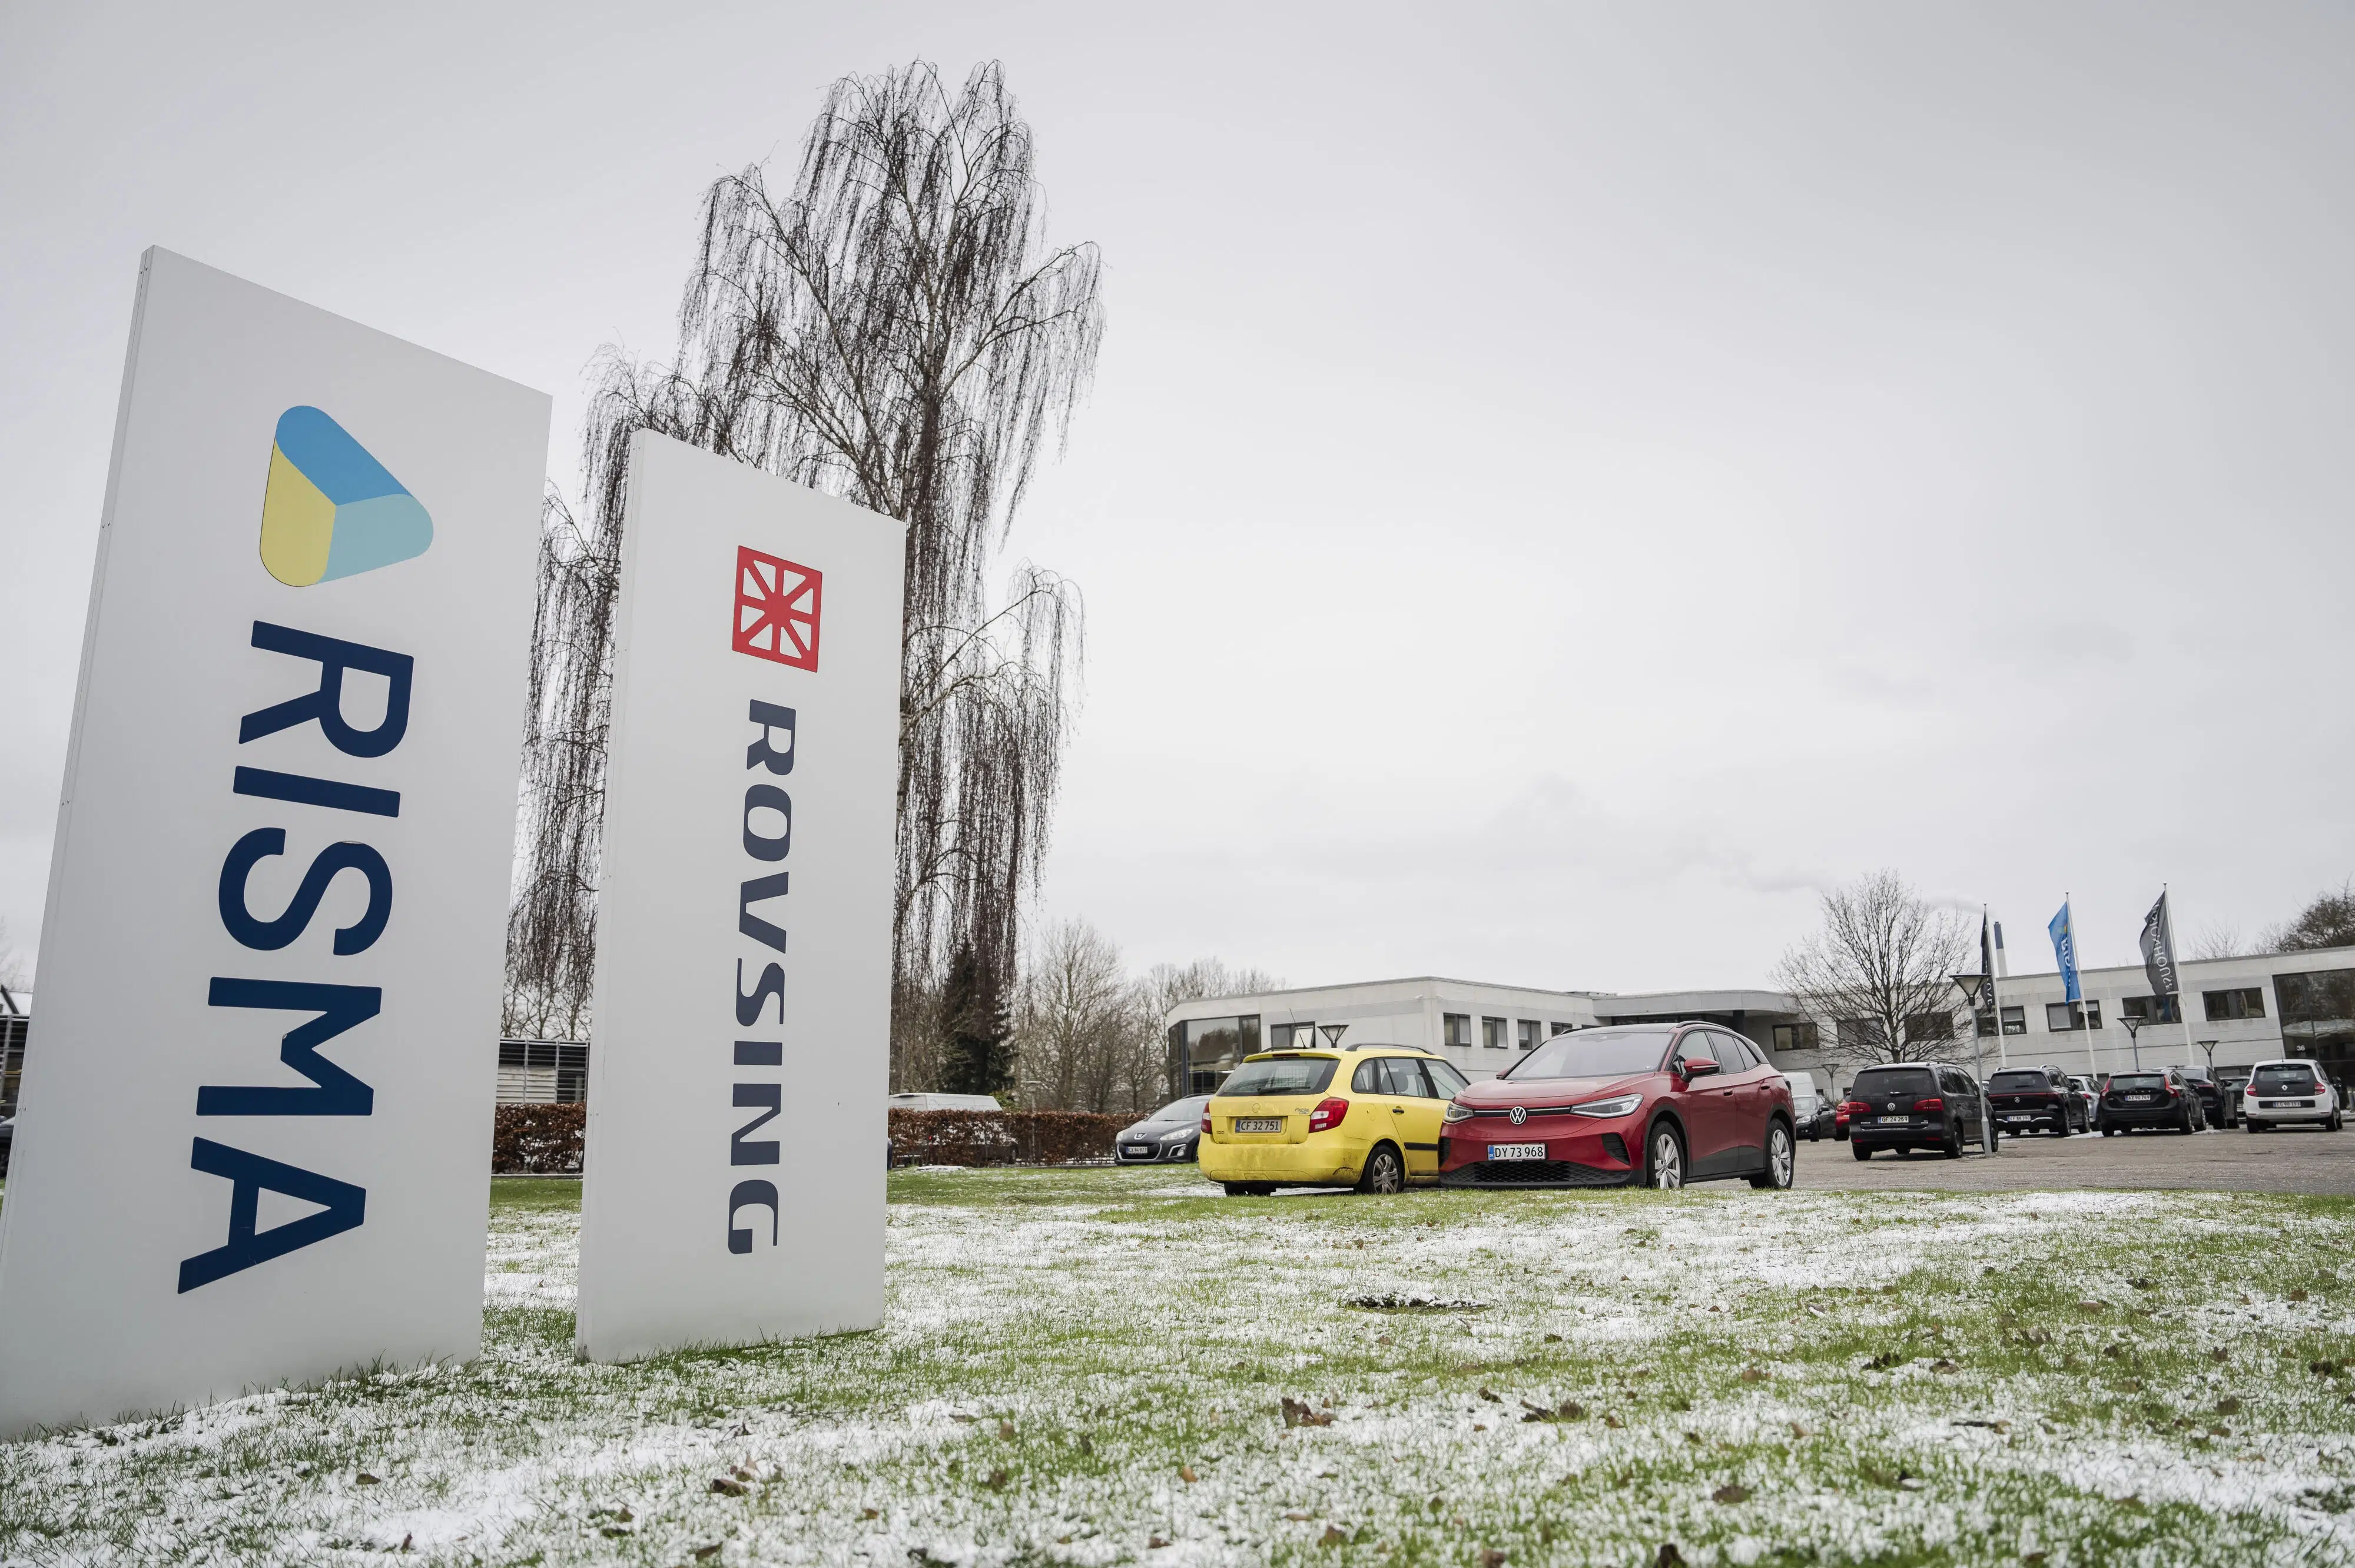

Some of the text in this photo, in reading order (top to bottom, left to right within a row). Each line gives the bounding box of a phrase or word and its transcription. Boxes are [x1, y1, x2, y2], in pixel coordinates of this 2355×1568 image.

[177, 620, 414, 1294] RISMA
[728, 699, 796, 1254] ROVSING
[1240, 1121, 1279, 1130] CF 32 751
[1495, 1147, 1543, 1158] DY 73 968
